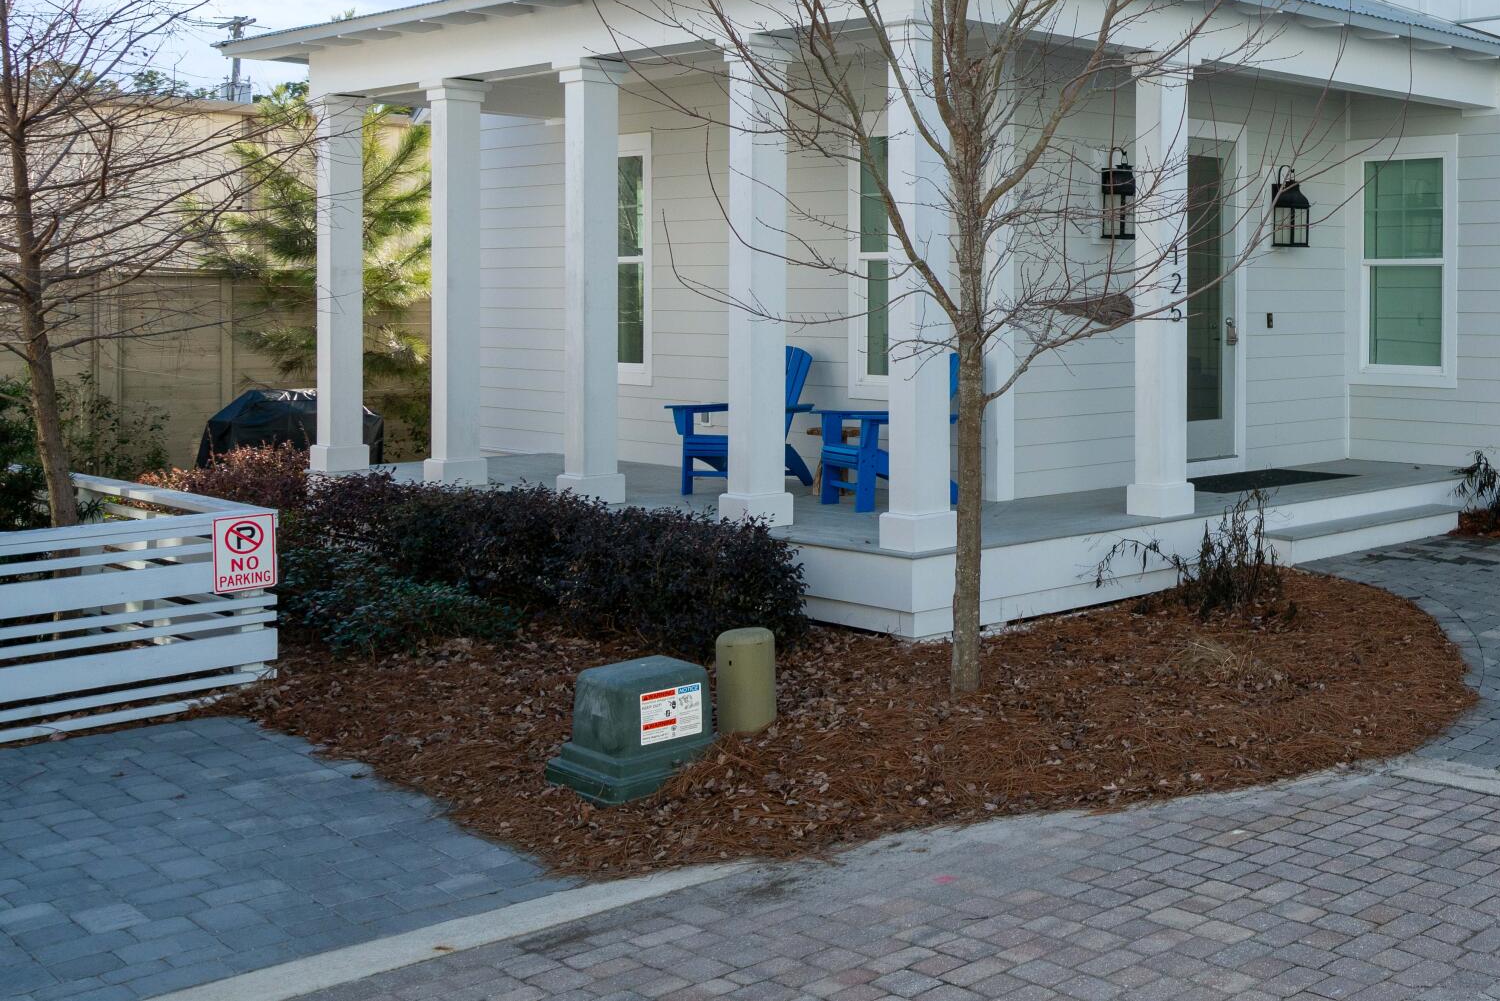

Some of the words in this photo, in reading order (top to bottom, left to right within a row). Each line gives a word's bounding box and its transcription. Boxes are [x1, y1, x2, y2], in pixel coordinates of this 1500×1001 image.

[1170, 245, 1182, 322] 125
[231, 556, 259, 572] NO
[220, 570, 271, 588] PARKING
[647, 690, 675, 700] WARNING
[679, 685, 698, 693] NOTICE
